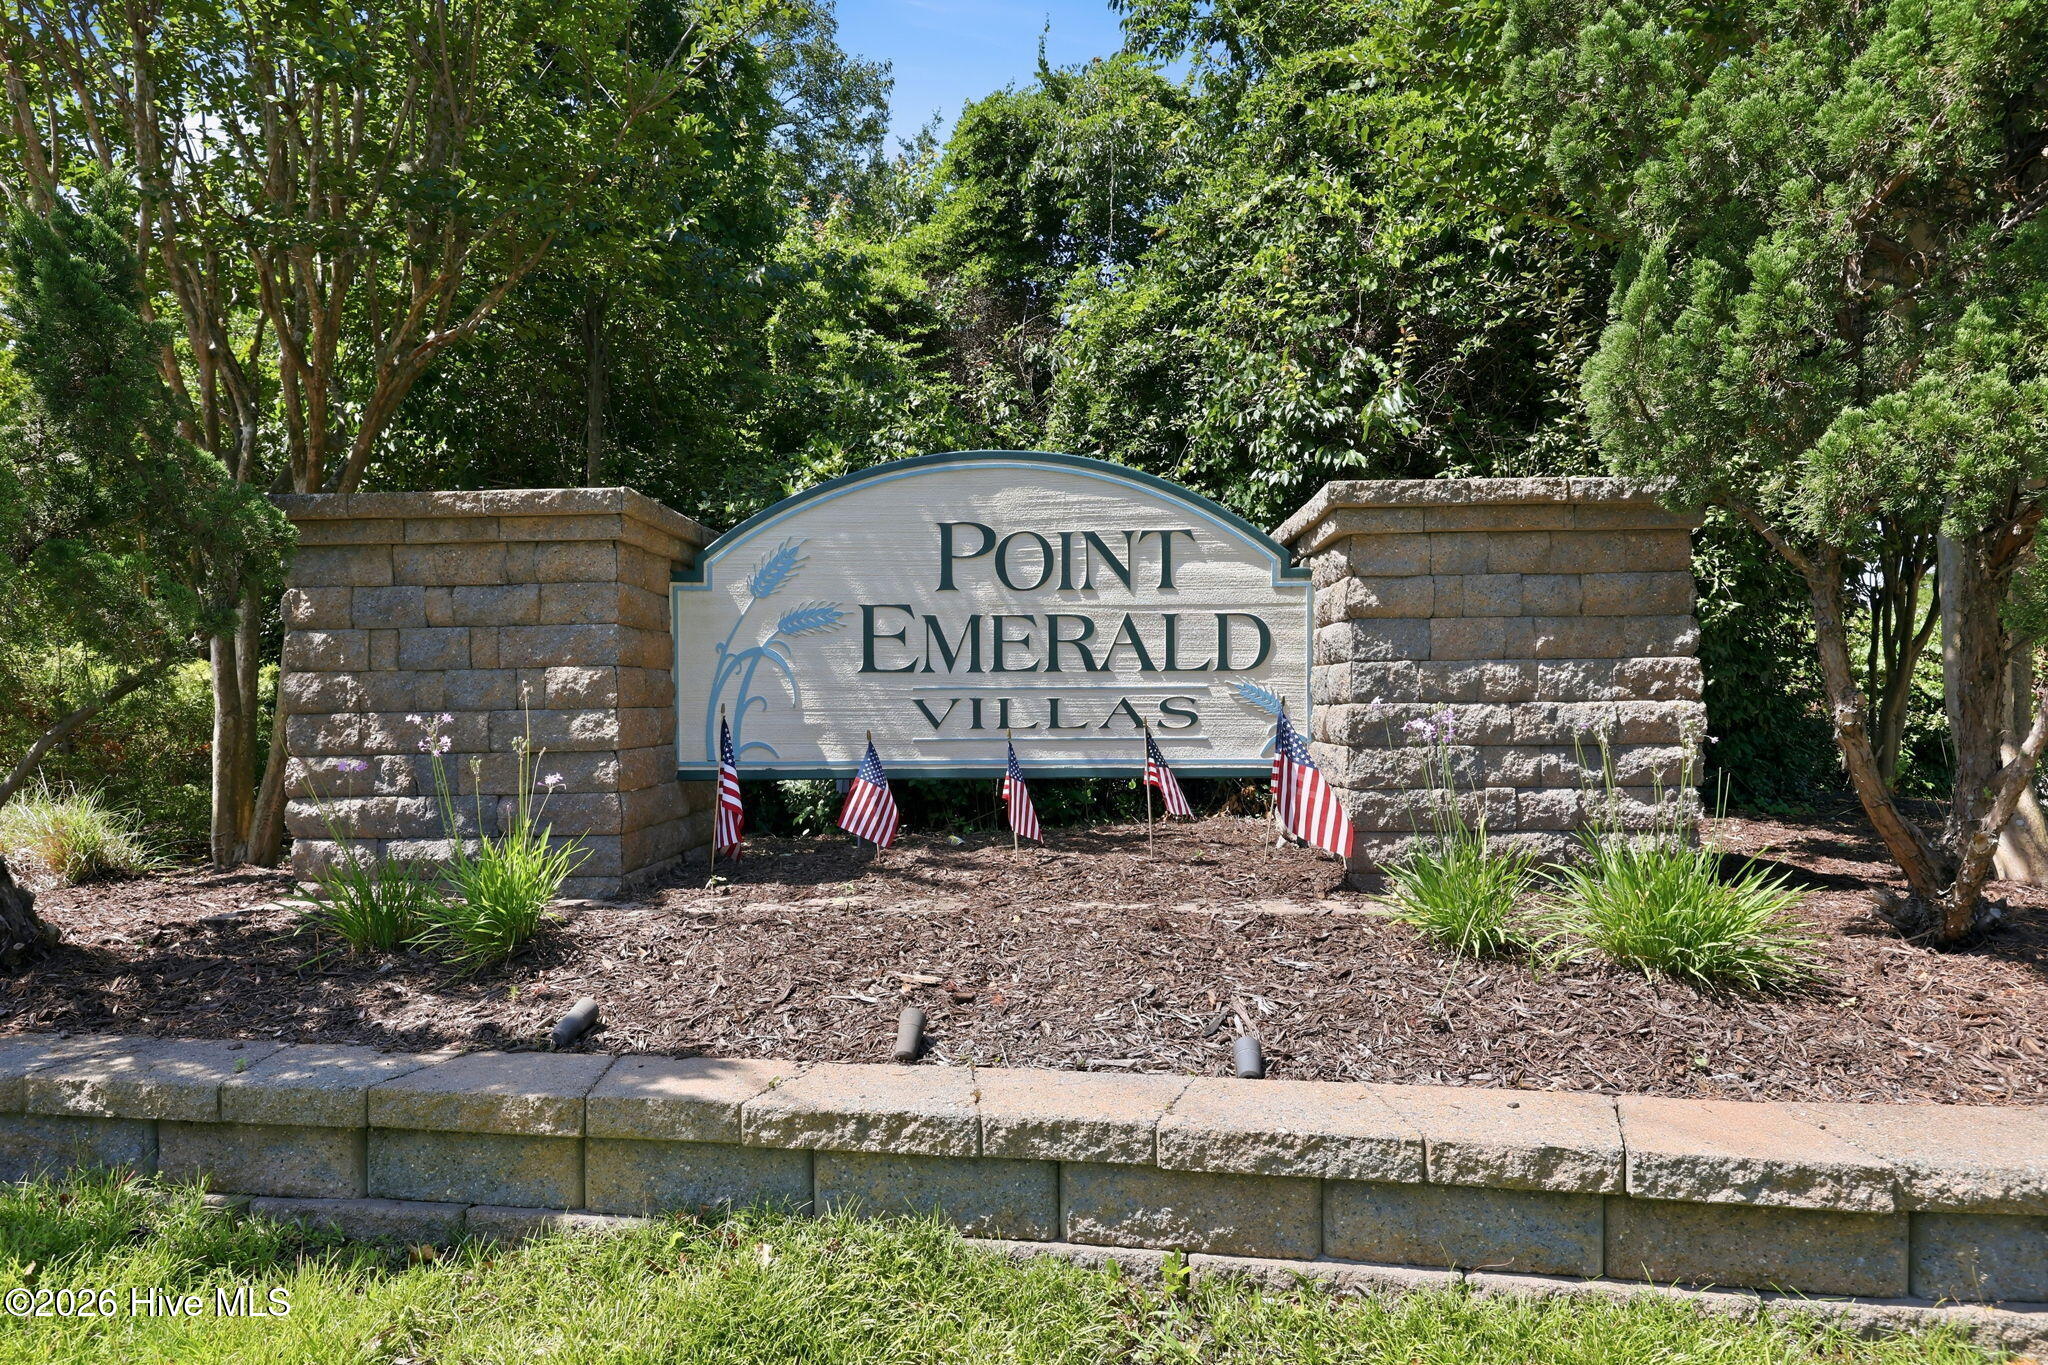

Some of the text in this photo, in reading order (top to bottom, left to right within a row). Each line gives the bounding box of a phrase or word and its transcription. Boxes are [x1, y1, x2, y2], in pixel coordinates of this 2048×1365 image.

[935, 521, 1196, 592] POINT
[858, 604, 1271, 674] EMERALD
[912, 696, 1199, 730] VILLAS
